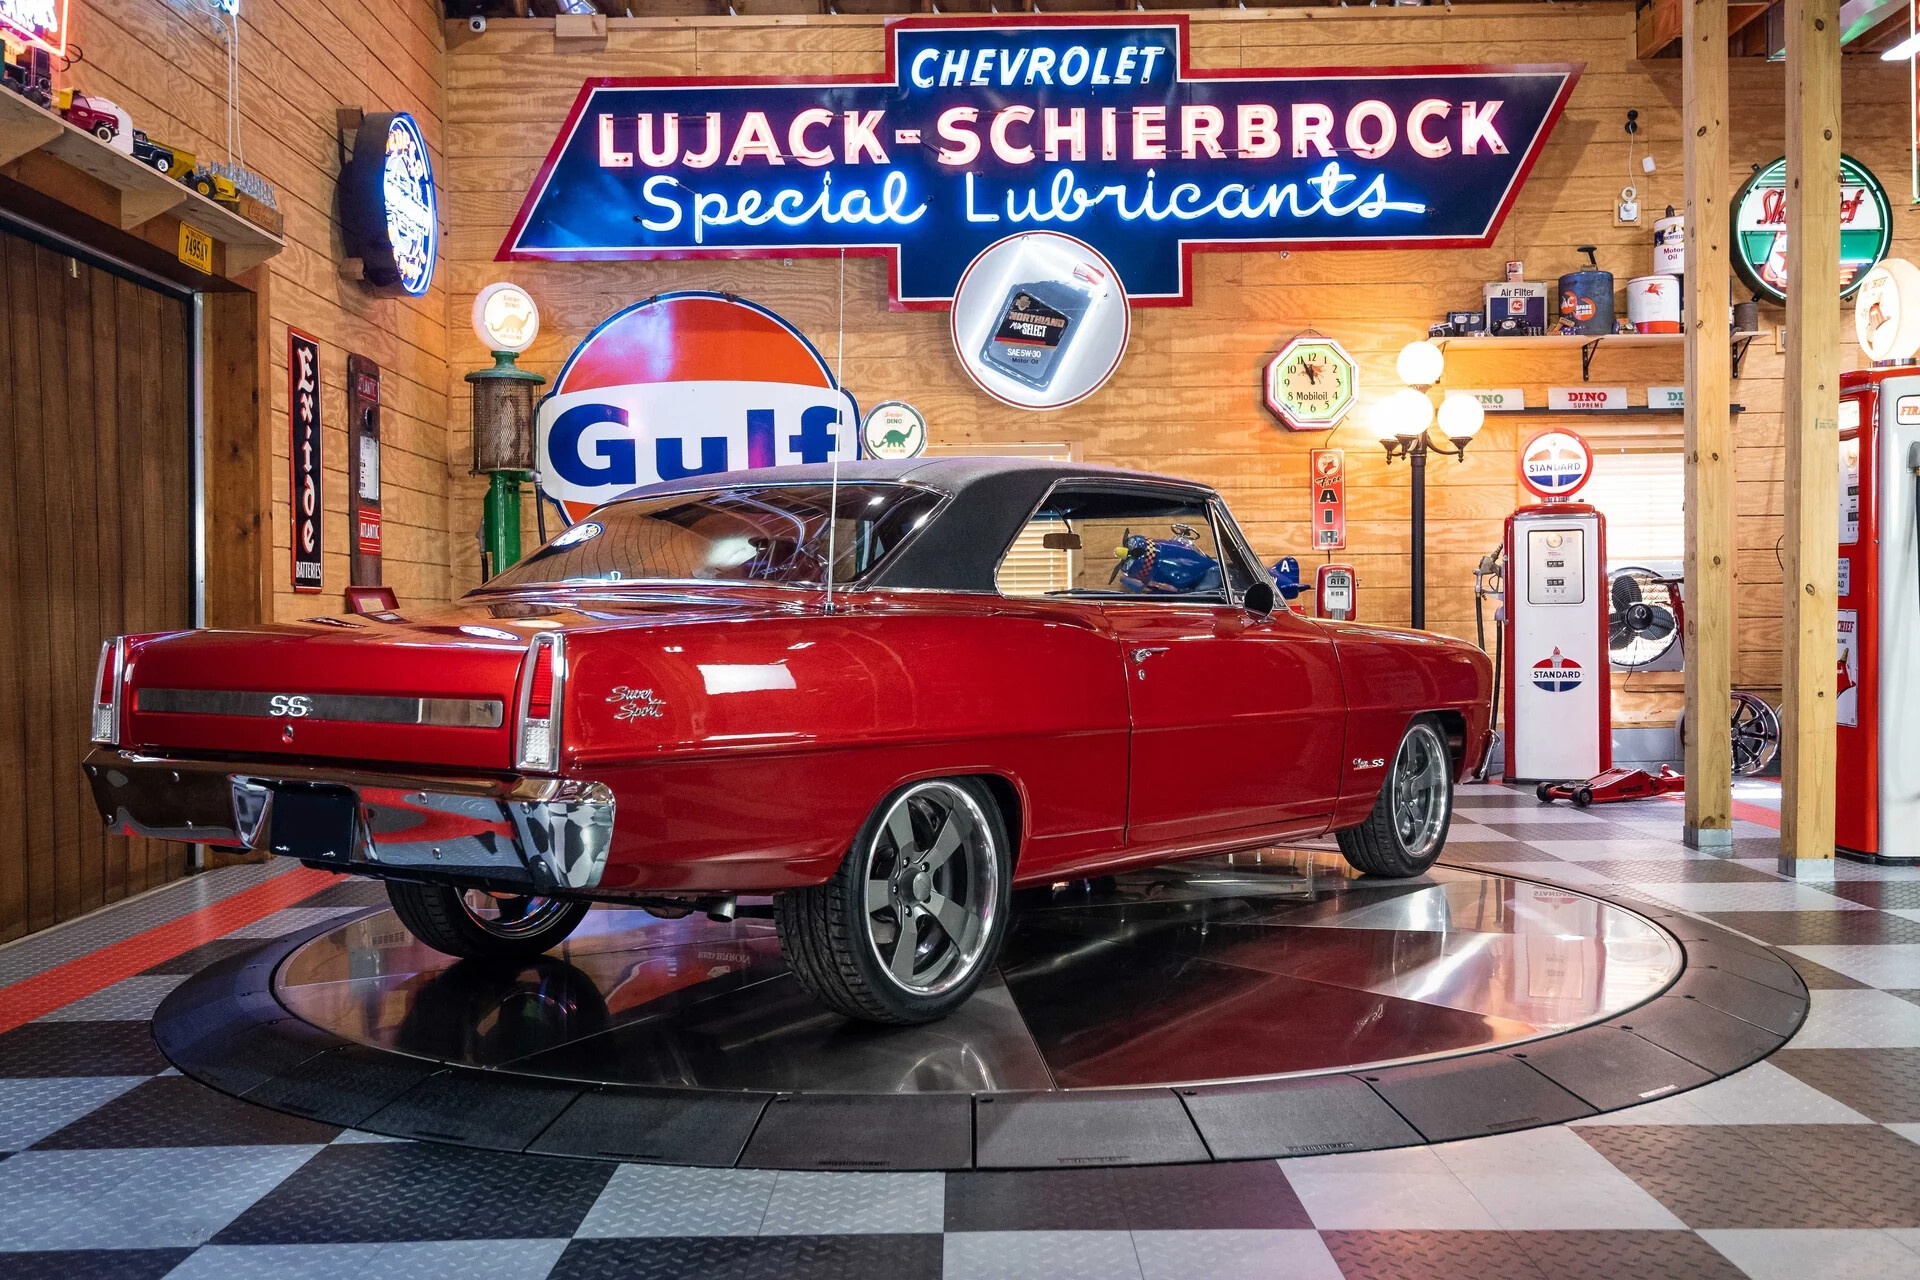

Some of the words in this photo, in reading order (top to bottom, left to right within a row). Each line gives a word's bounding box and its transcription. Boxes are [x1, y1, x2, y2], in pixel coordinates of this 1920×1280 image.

[911, 46, 1166, 88] CHEVROLET
[640, 170, 930, 244] Special
[966, 161, 1427, 223] Lubricants
[1501, 289, 1511, 297] Air
[1514, 288, 1534, 297] Filter
[1561, 296, 1575, 308] AC
[1009, 312, 1066, 328] NORTHLAND
[1022, 323, 1047, 338] SELECT
[1007, 348, 1020, 356] SAE
[1021, 349, 1042, 358] 5W-30
[1308, 353, 1317, 361] 12
[1324, 356, 1327, 364] 1
[1287, 365, 1297, 374] 10
[1333, 365, 1338, 373] 2
[1284, 378, 1290, 387] 9
[1336, 378, 1341, 387] 3
[1288, 392, 1293, 400] 8
[1296, 391, 1328, 400] Mobiloil
[1332, 392, 1338, 400] 4
[1568, 391, 1607, 402] DINO
[1667, 392, 1684, 401] DI
[1298, 402, 1302, 410] 7
[1310, 404, 1316, 412] 6
[1324, 401, 1330, 410] 5
[297, 346, 315, 554] Exide
[548, 403, 843, 487] Gulf
[1529, 462, 1581, 473] STANDARD
[1315, 475, 1342, 487] Free
[1318, 489, 1339, 545] AIR
[360, 522, 380, 541] ATLANTIC
[296, 560, 321, 580] BATTERIES
[1280, 560, 1290, 572] A
[1533, 670, 1581, 679] STANDARD
[269, 694, 309, 717] SS
[613, 699, 667, 723] Sport
[1372, 758, 1384, 767] SS
